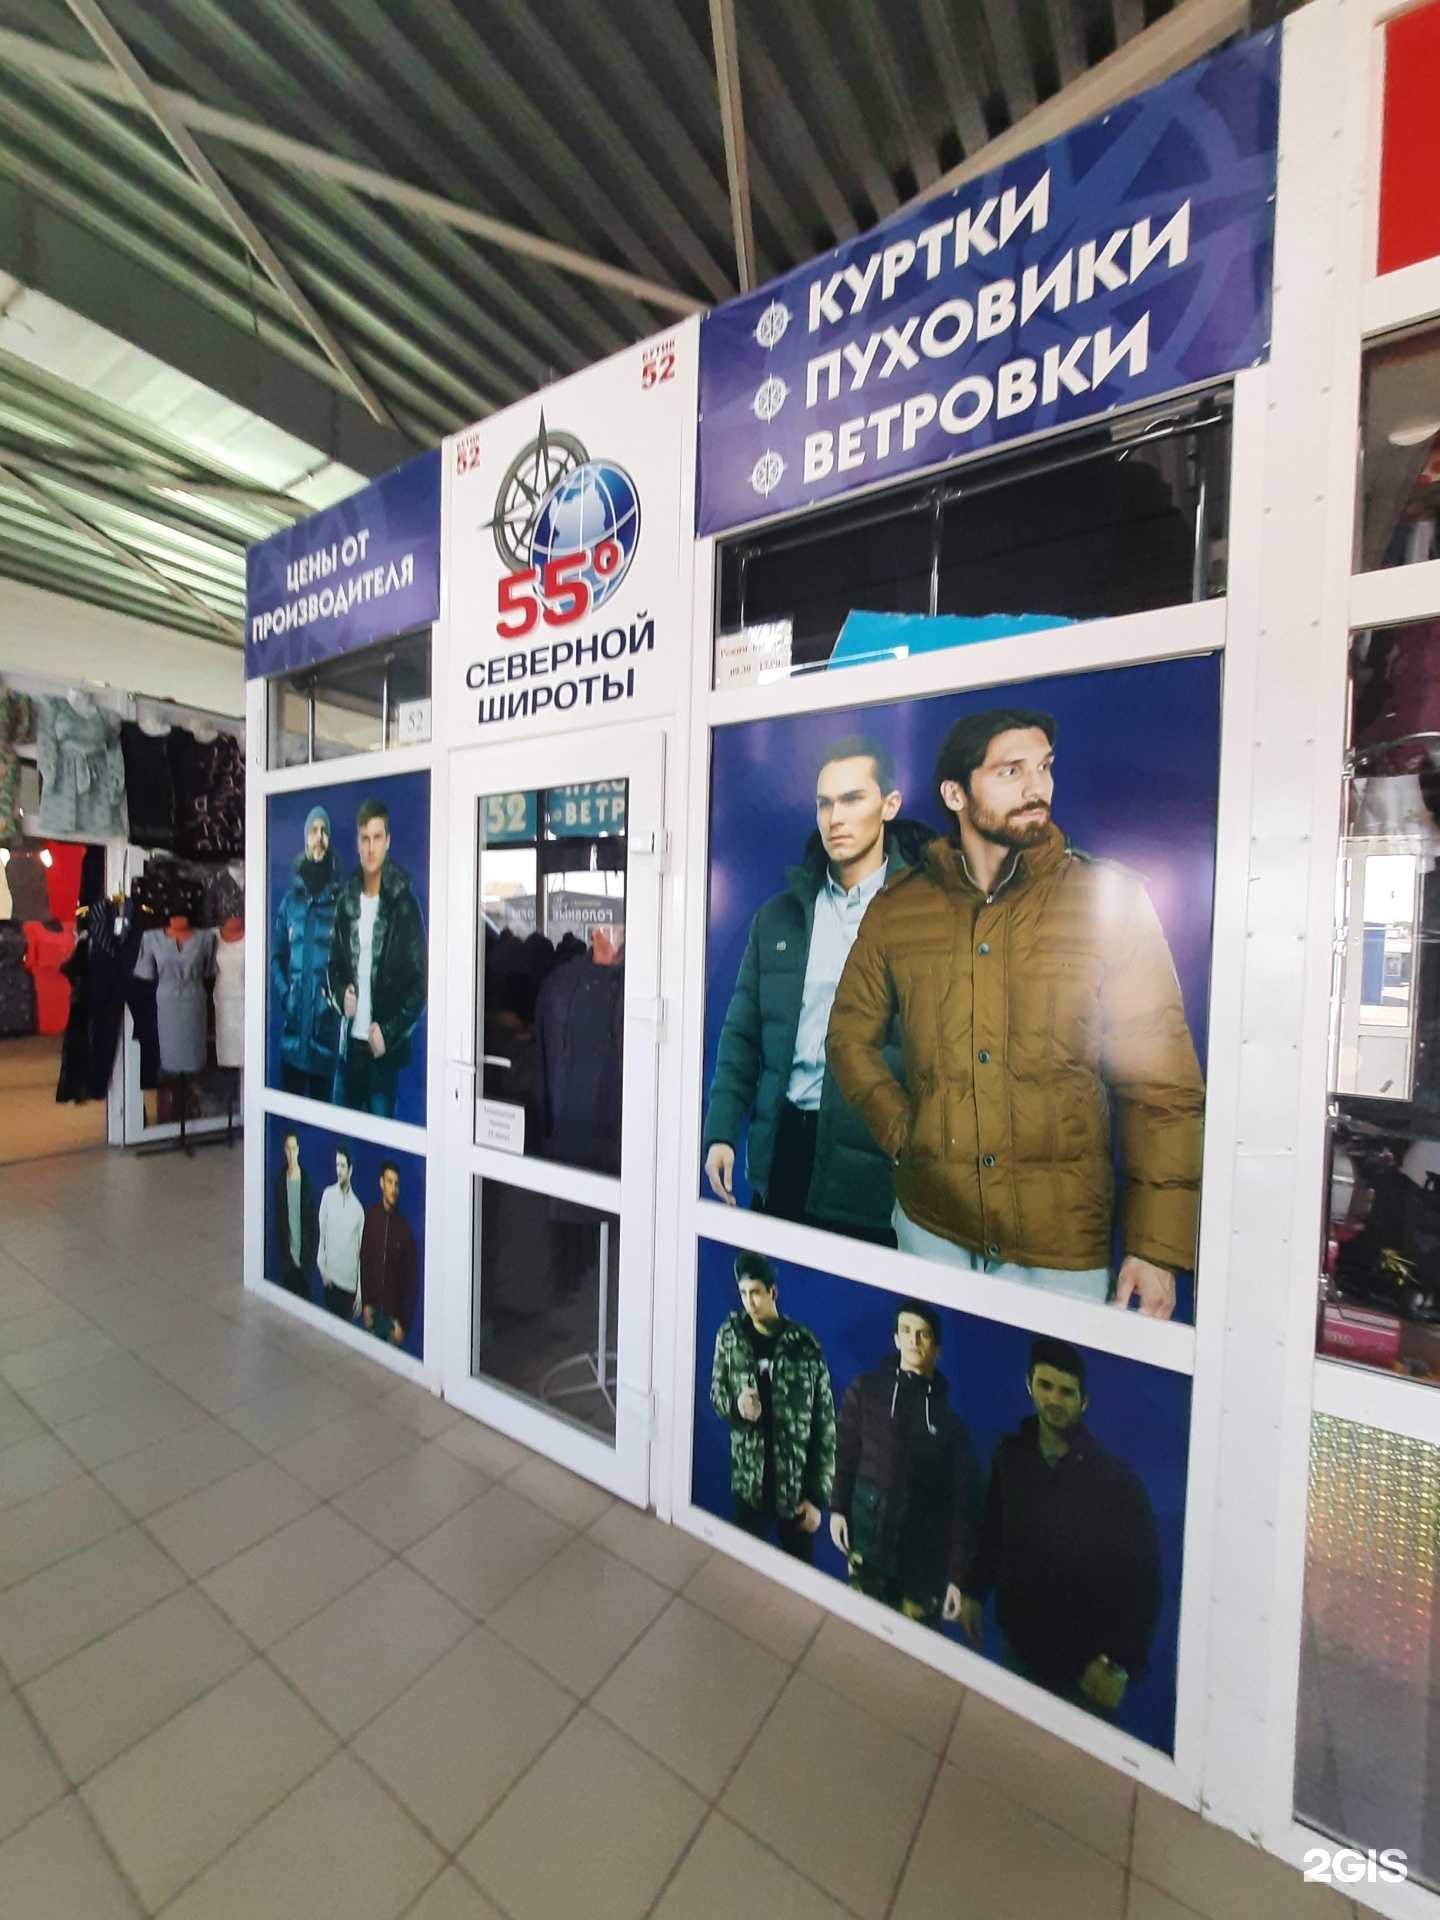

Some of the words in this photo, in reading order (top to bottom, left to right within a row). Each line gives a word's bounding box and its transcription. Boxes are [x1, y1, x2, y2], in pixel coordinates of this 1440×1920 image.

[808, 168, 1051, 334] КУРТКИ
[805, 198, 1191, 409] ПУХОВИКИ
[641, 354, 676, 390] 52
[803, 310, 1150, 484] ВЕТРОВКИ
[456, 446, 480, 475] 52
[252, 552, 414, 644] ПРОИЗВОДИТЕЛЯ
[286, 543, 337, 593] ЦЕНЫ
[341, 528, 370, 567] ОТ
[465, 608, 655, 690] СЕВЕРНОЙ
[477, 667, 635, 725] ШИРОТЫ
